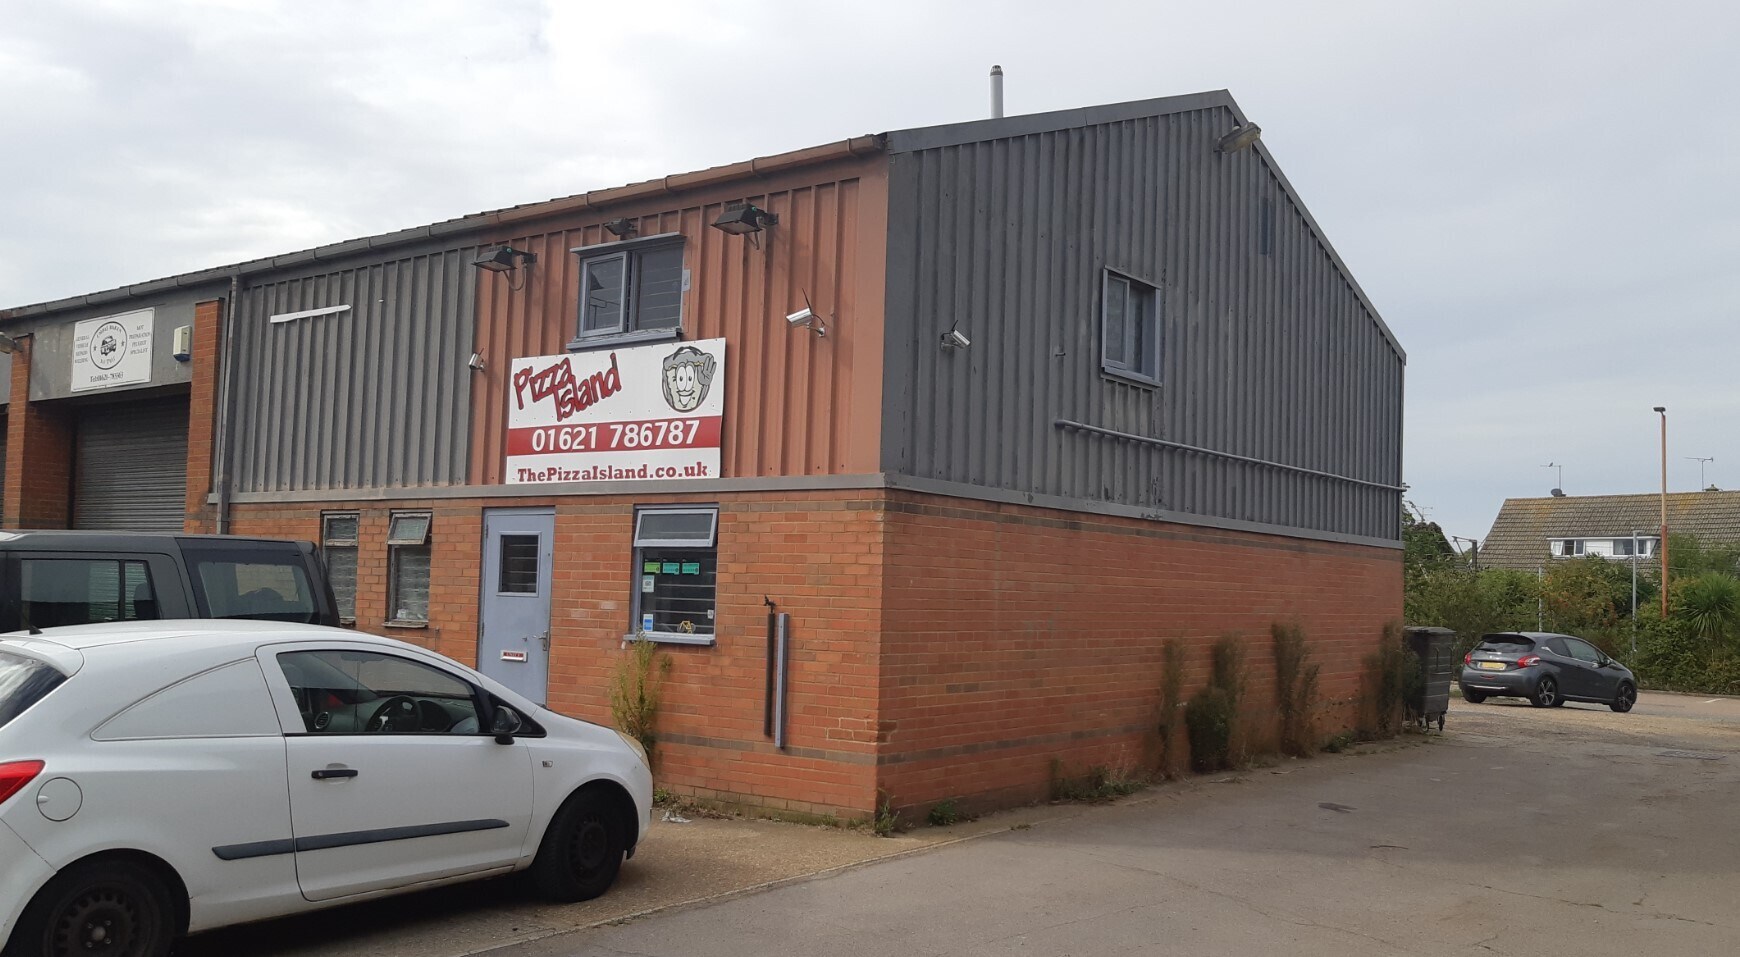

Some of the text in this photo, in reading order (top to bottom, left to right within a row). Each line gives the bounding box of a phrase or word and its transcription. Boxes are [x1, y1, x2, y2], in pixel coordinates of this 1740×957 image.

[514, 357, 573, 410] Pizza
[552, 352, 622, 422] Island
[532, 420, 700, 451] 01621 786787
[517, 462, 708, 482] ThePizzaIsland.co.uk
